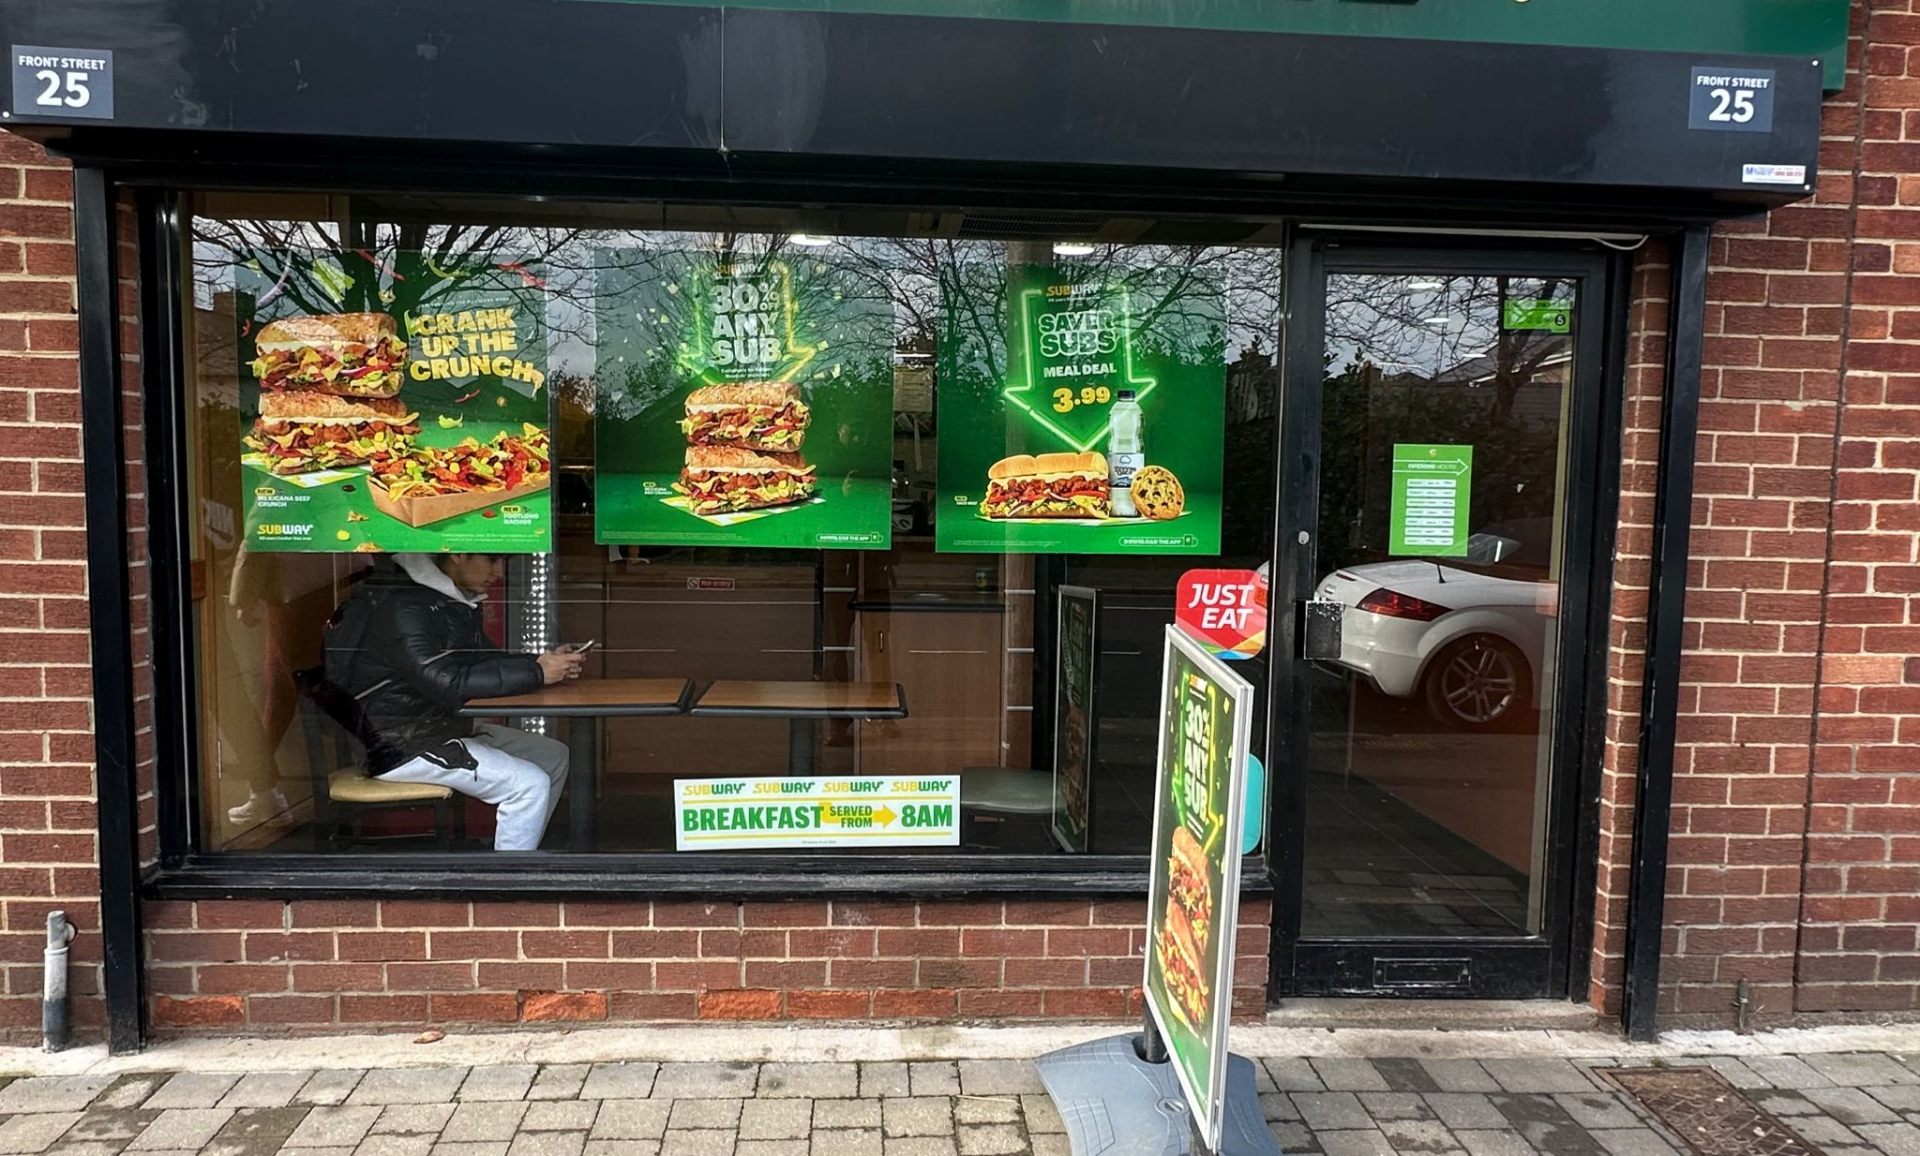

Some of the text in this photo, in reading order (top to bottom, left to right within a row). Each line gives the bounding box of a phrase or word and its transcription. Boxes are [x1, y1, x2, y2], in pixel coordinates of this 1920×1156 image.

[19, 56, 106, 70] FRONT STREET
[36, 70, 90, 108] 25
[1697, 76, 1770, 89] FRONT STREET
[1709, 89, 1754, 123] 25
[1046, 284, 1102, 296] SUBWAY
[415, 308, 518, 335] CRANK
[712, 312, 779, 338] ANY
[1039, 310, 1116, 333] SAVER
[421, 330, 518, 357] UP THE
[711, 337, 782, 366] SUB
[1040, 329, 1118, 357] SUBS
[410, 355, 534, 381] CRUNCH
[1043, 363, 1117, 378] MEAL DEAL
[1052, 386, 1111, 413] 3.99
[256, 524, 314, 535] SUBWAY
[1188, 583, 1255, 608] JUST
[1201, 607, 1254, 630] EAT
[683, 780, 953, 796] SUBWAY SUBWAY SUBWAY SUBWAY
[1183, 771, 1208, 824] SUB
[682, 806, 825, 832] BREAKFAST
[829, 805, 873, 817] SERVED
[841, 817, 873, 828] FROM
[901, 804, 953, 828] 8AM
